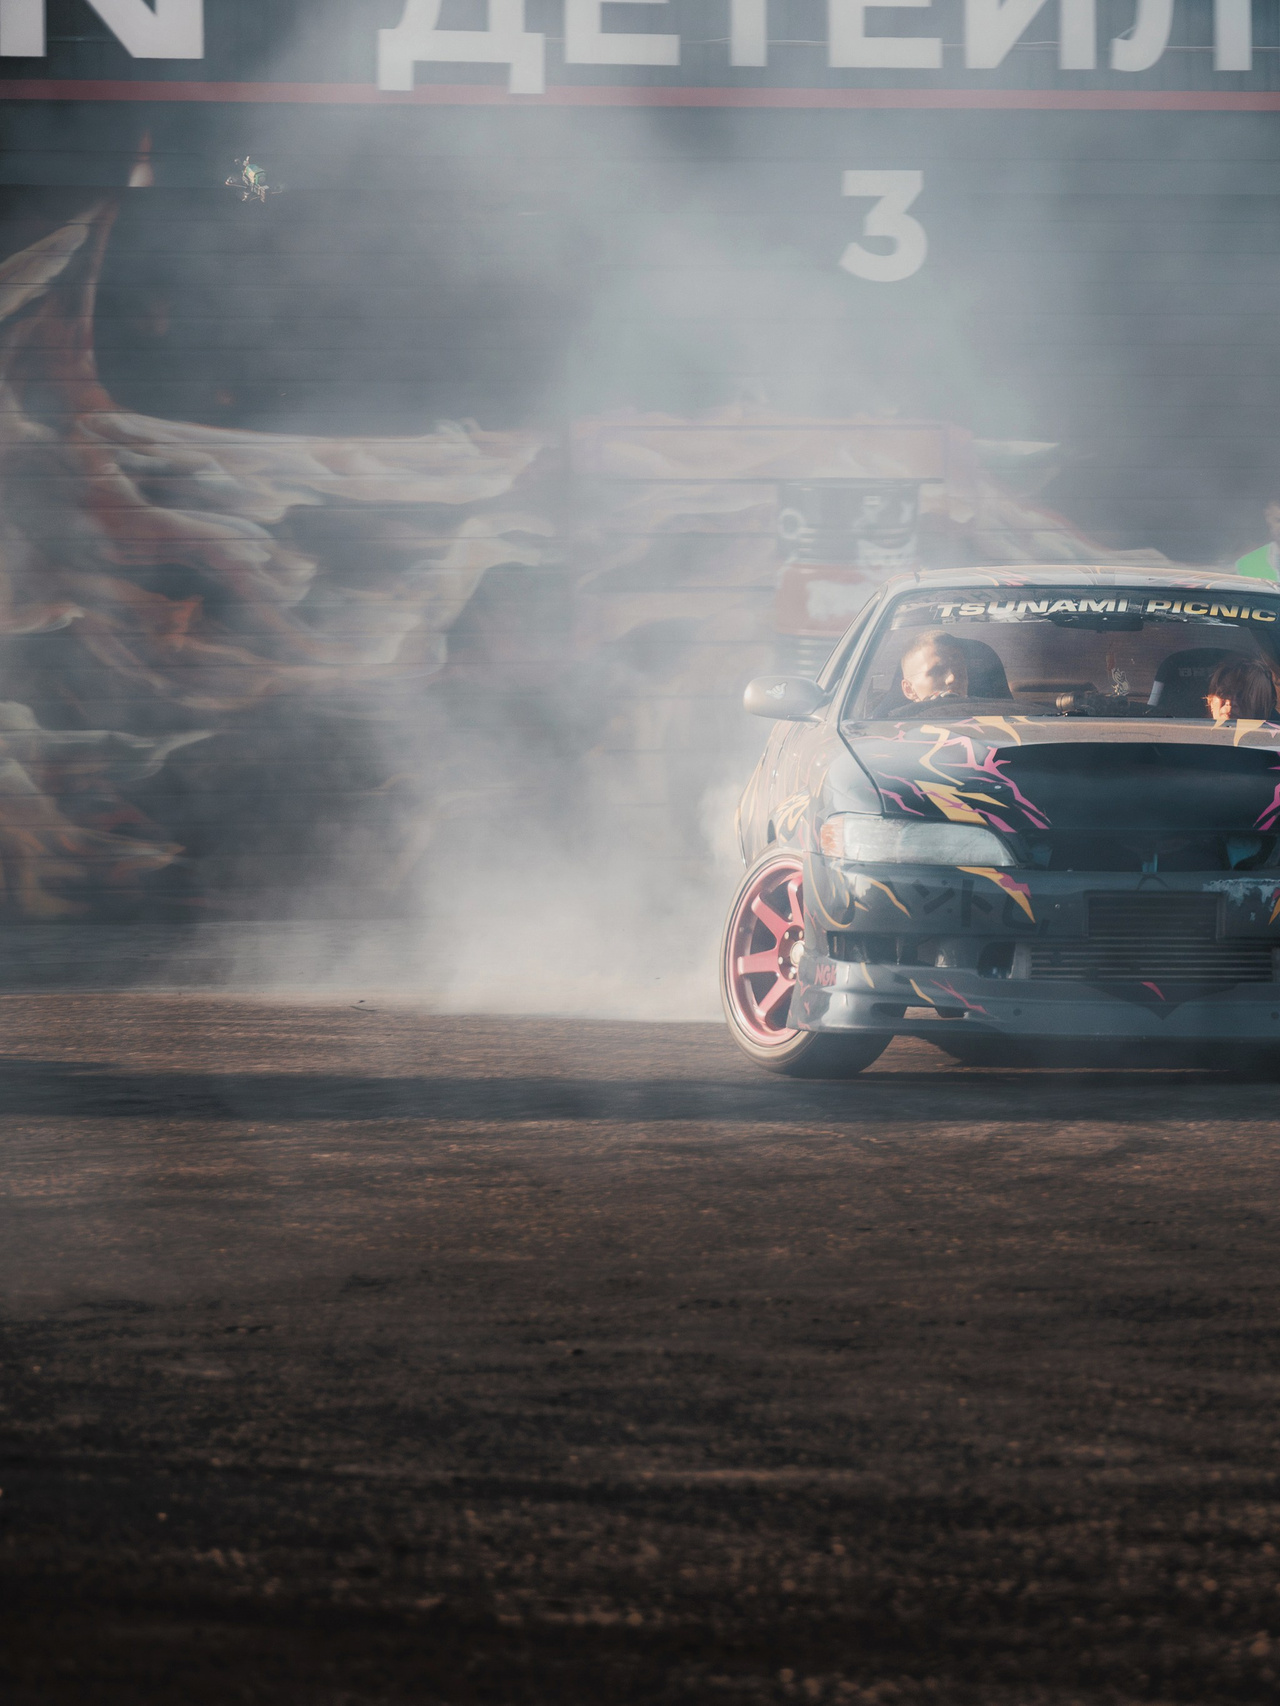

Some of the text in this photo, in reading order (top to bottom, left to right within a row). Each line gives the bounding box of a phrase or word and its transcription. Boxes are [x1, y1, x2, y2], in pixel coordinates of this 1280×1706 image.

[838, 169, 928, 283] 3
[937, 599, 1277, 622] TSUNAMI PICNIC
[814, 963, 839, 986] NGK
